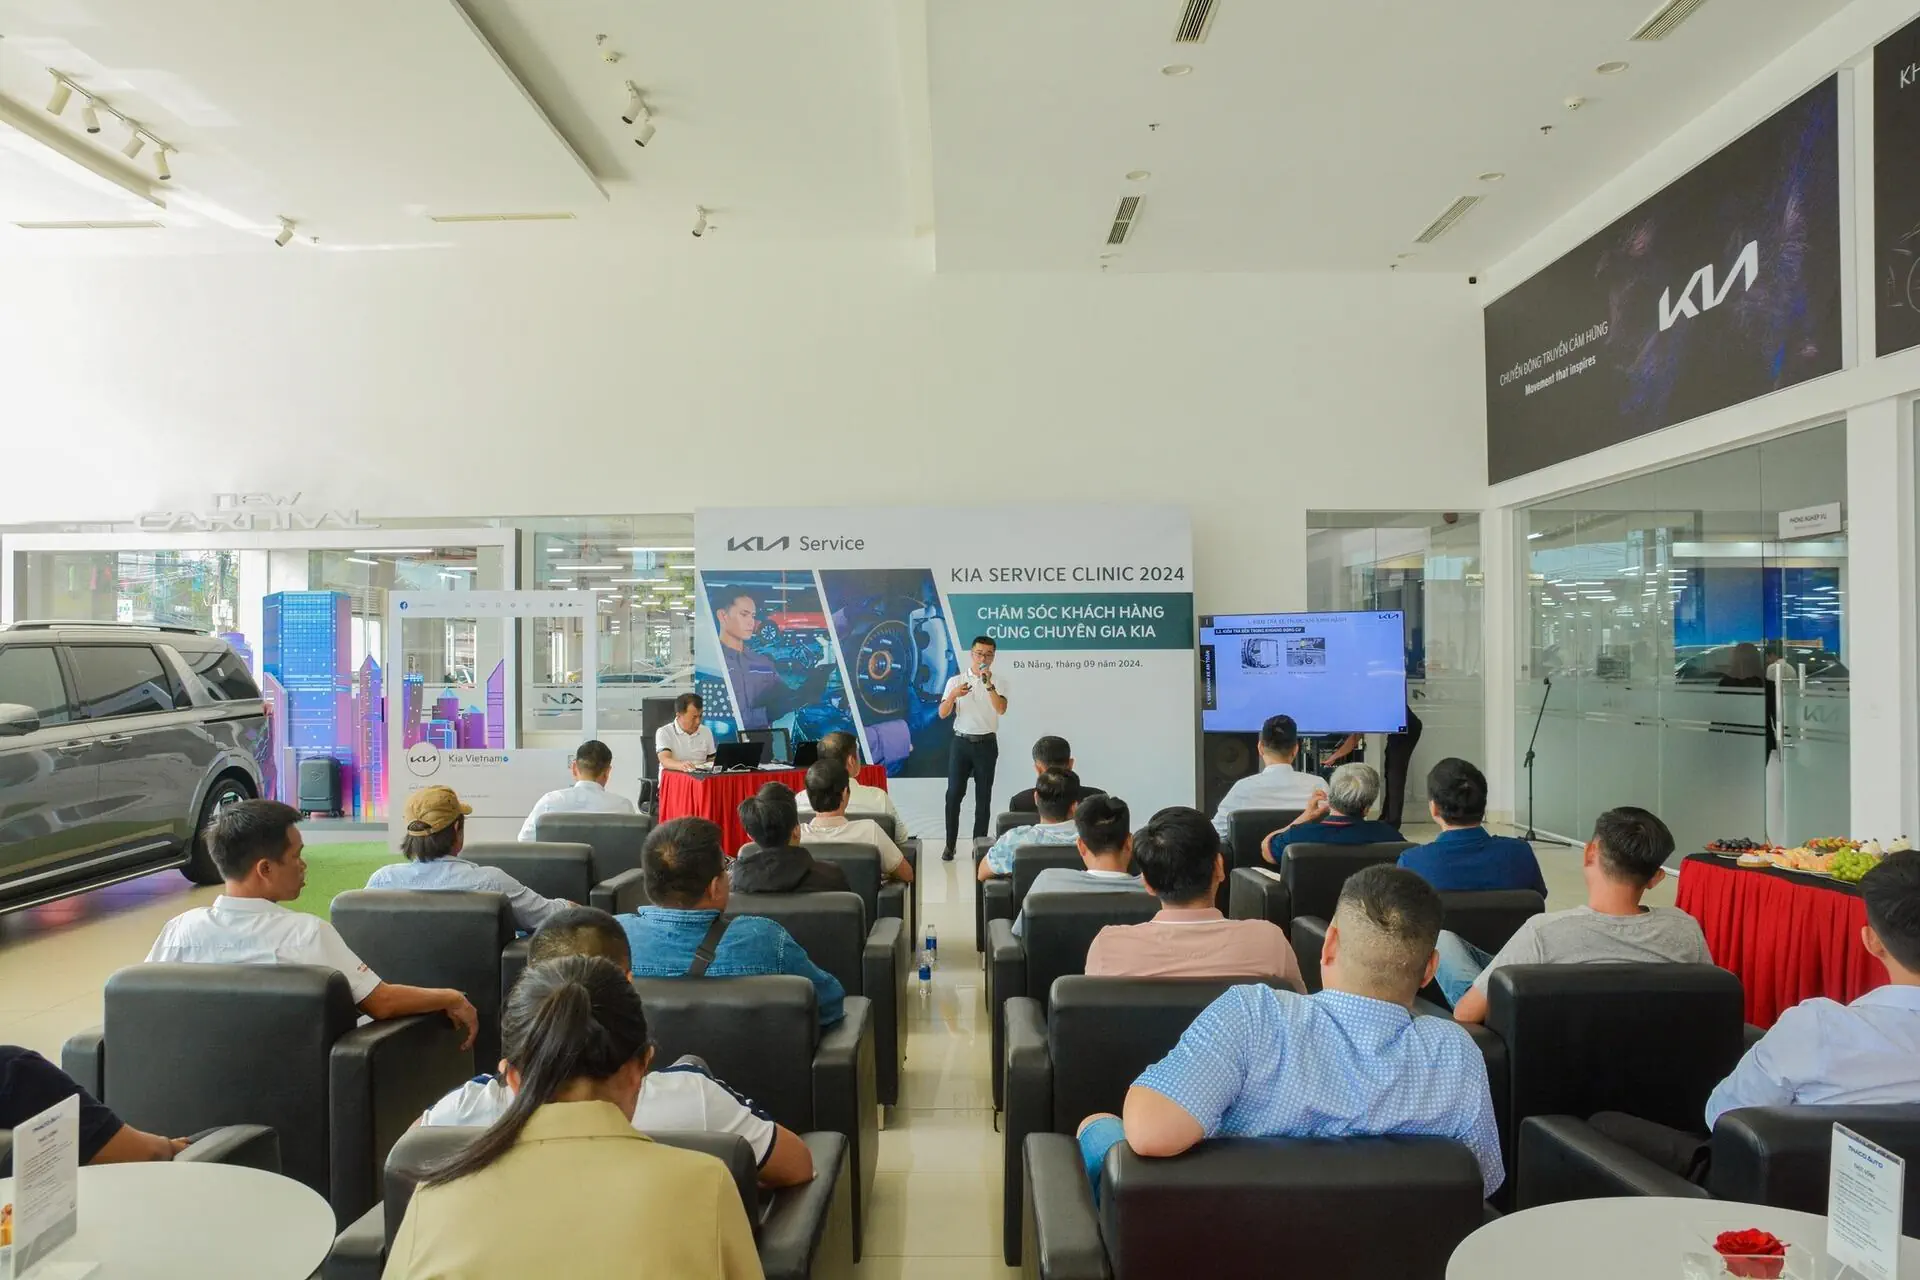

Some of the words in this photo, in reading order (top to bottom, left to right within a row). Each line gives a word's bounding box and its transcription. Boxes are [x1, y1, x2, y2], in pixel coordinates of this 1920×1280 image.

[1659, 240, 1758, 331] KIA
[1524, 373, 1555, 396] Movement
[1555, 366, 1569, 381] that
[1569, 355, 1597, 374] inspires
[134, 508, 382, 532] CARNIVAL
[727, 536, 790, 551] KIA
[799, 535, 865, 551] Service
[951, 567, 983, 582] KIA
[989, 567, 1067, 582] SERVICE
[1072, 566, 1134, 581] CLINIC
[1139, 566, 1185, 581] 2024
[977, 603, 1023, 620] CHĂM
[1027, 603, 1058, 619] SÓC
[1061, 604, 1116, 619] KHÁCH
[1119, 603, 1165, 618] HÀNG
[987, 624, 1030, 639] CÙNG
[1034, 623, 1096, 638] CHUYÊN
[1100, 625, 1127, 638] GIA
[1131, 625, 1156, 638] KIA
[1013, 660, 1025, 669] Đà
[1056, 660, 1081, 670] tháng
[1083, 660, 1095, 668] 09
[1098, 660, 1116, 668] năm
[1119, 659, 1143, 668] 2024.
[410, 755, 437, 763] KIA
[448, 754, 463, 763] Kia
[466, 754, 503, 763] Vietnam
